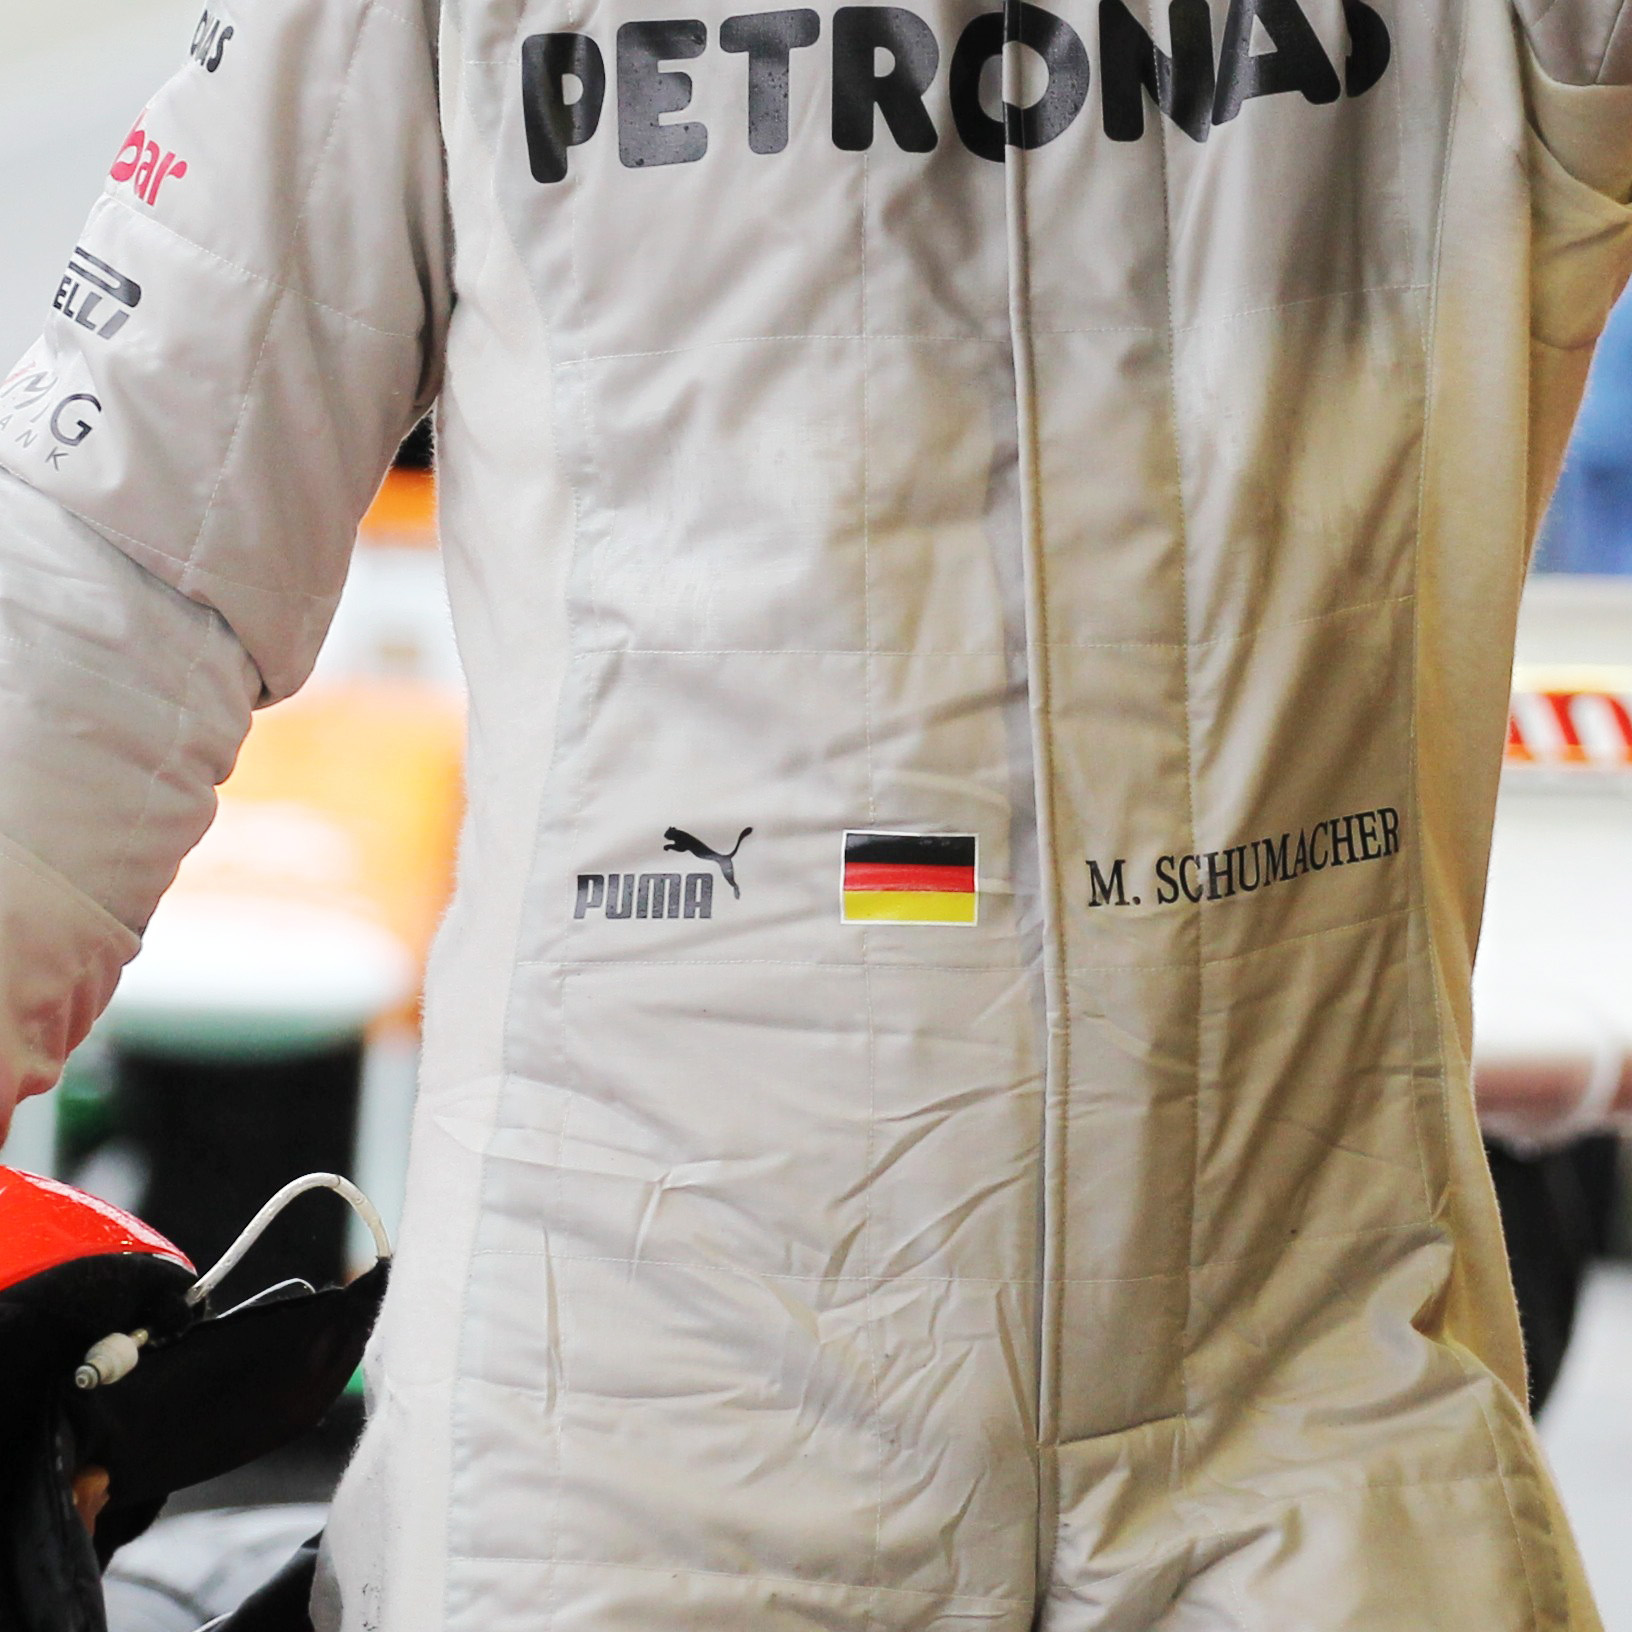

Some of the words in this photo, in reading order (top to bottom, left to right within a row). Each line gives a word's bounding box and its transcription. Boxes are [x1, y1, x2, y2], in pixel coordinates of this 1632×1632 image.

[573, 871, 716, 921] PUMA
[1087, 858, 1141, 909] M.
[1155, 807, 1401, 904] SCHUMACHER
